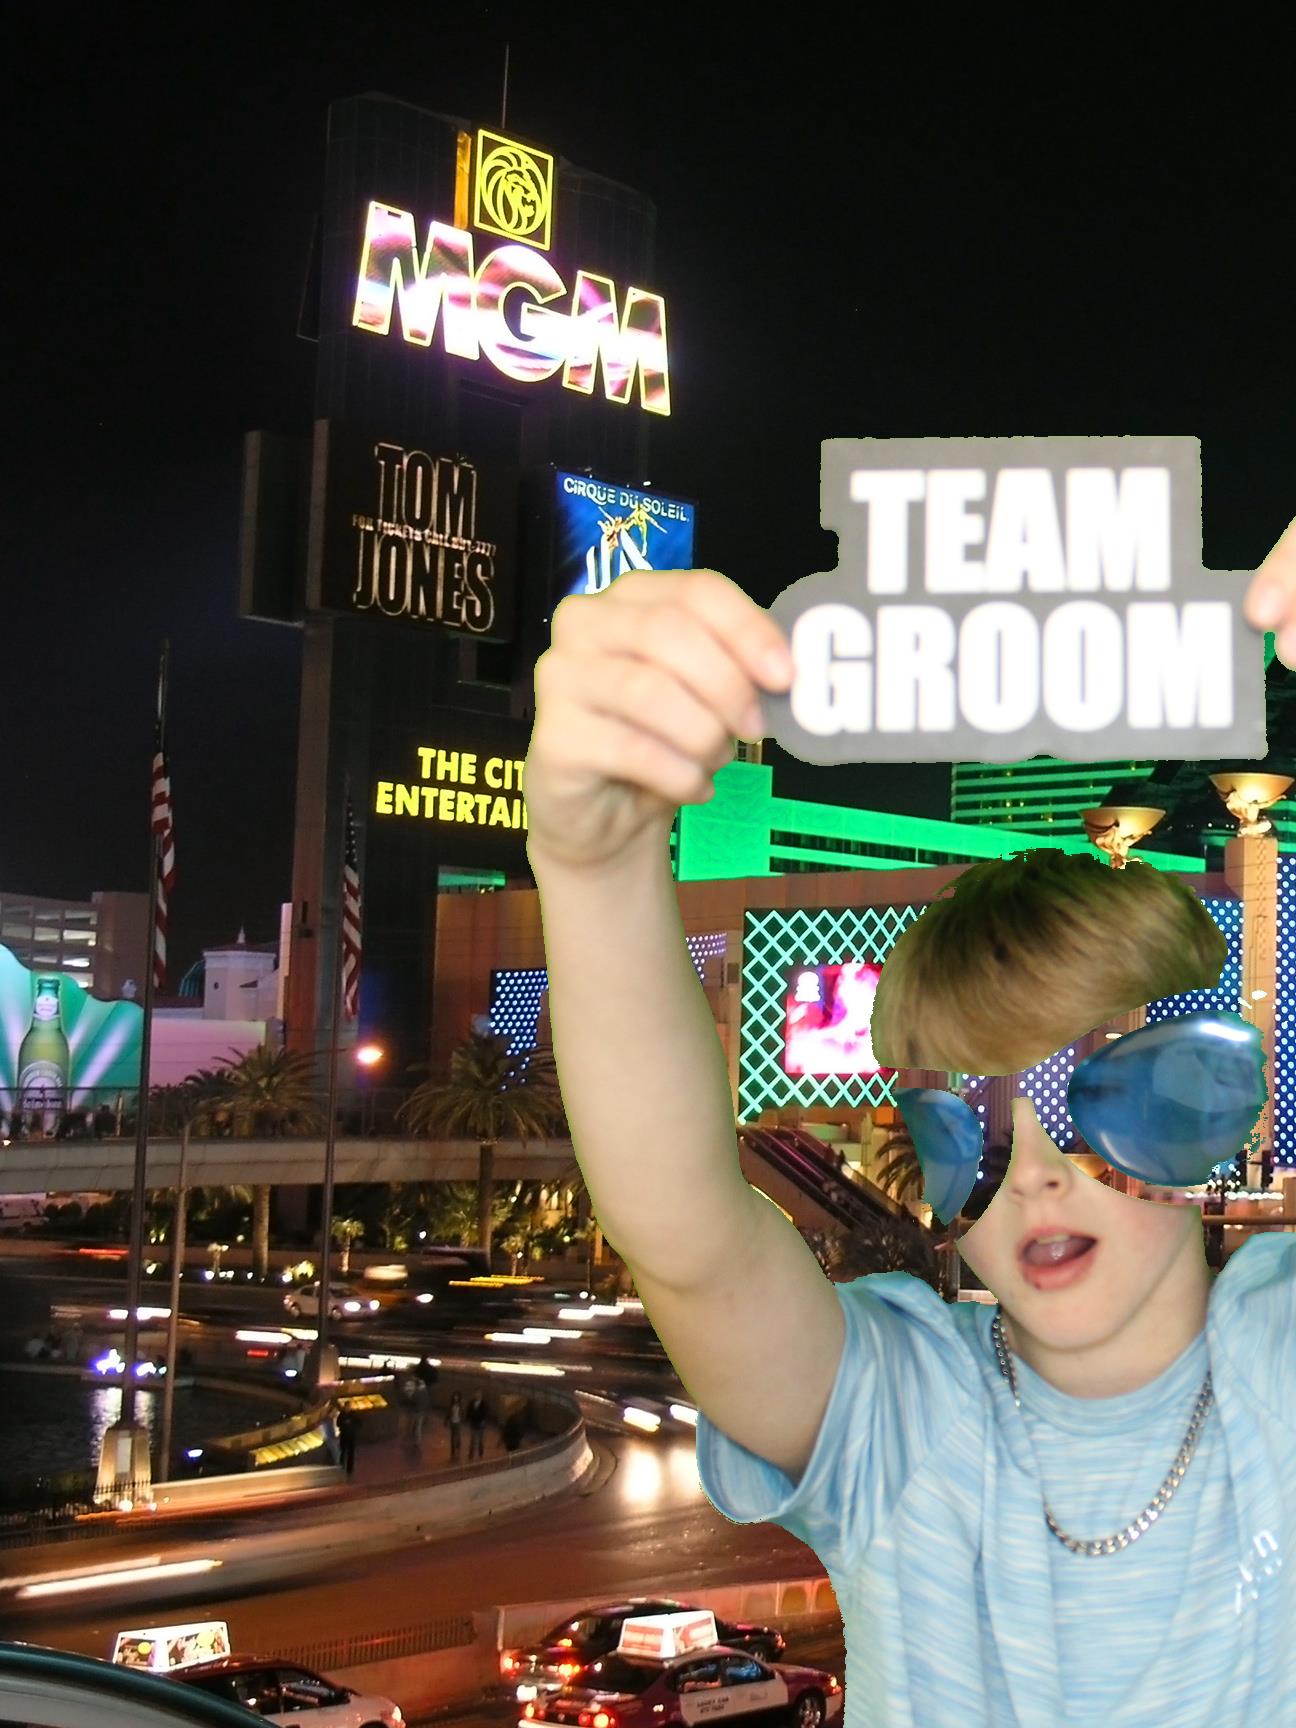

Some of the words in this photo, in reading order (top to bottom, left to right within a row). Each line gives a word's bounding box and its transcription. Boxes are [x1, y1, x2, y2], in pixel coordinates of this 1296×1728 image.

[352, 200, 671, 416] MGM
[375, 442, 477, 540] TOM
[563, 477, 616, 505] CIRQUE
[620, 492, 639, 509] DU
[642, 497, 688, 522] SOLEIL
[850, 466, 1171, 595] TEAM
[353, 530, 495, 632] JONES
[790, 600, 1233, 736] GROOM
[375, 781, 528, 830] ENTERTAI
[418, 747, 477, 785] THE
